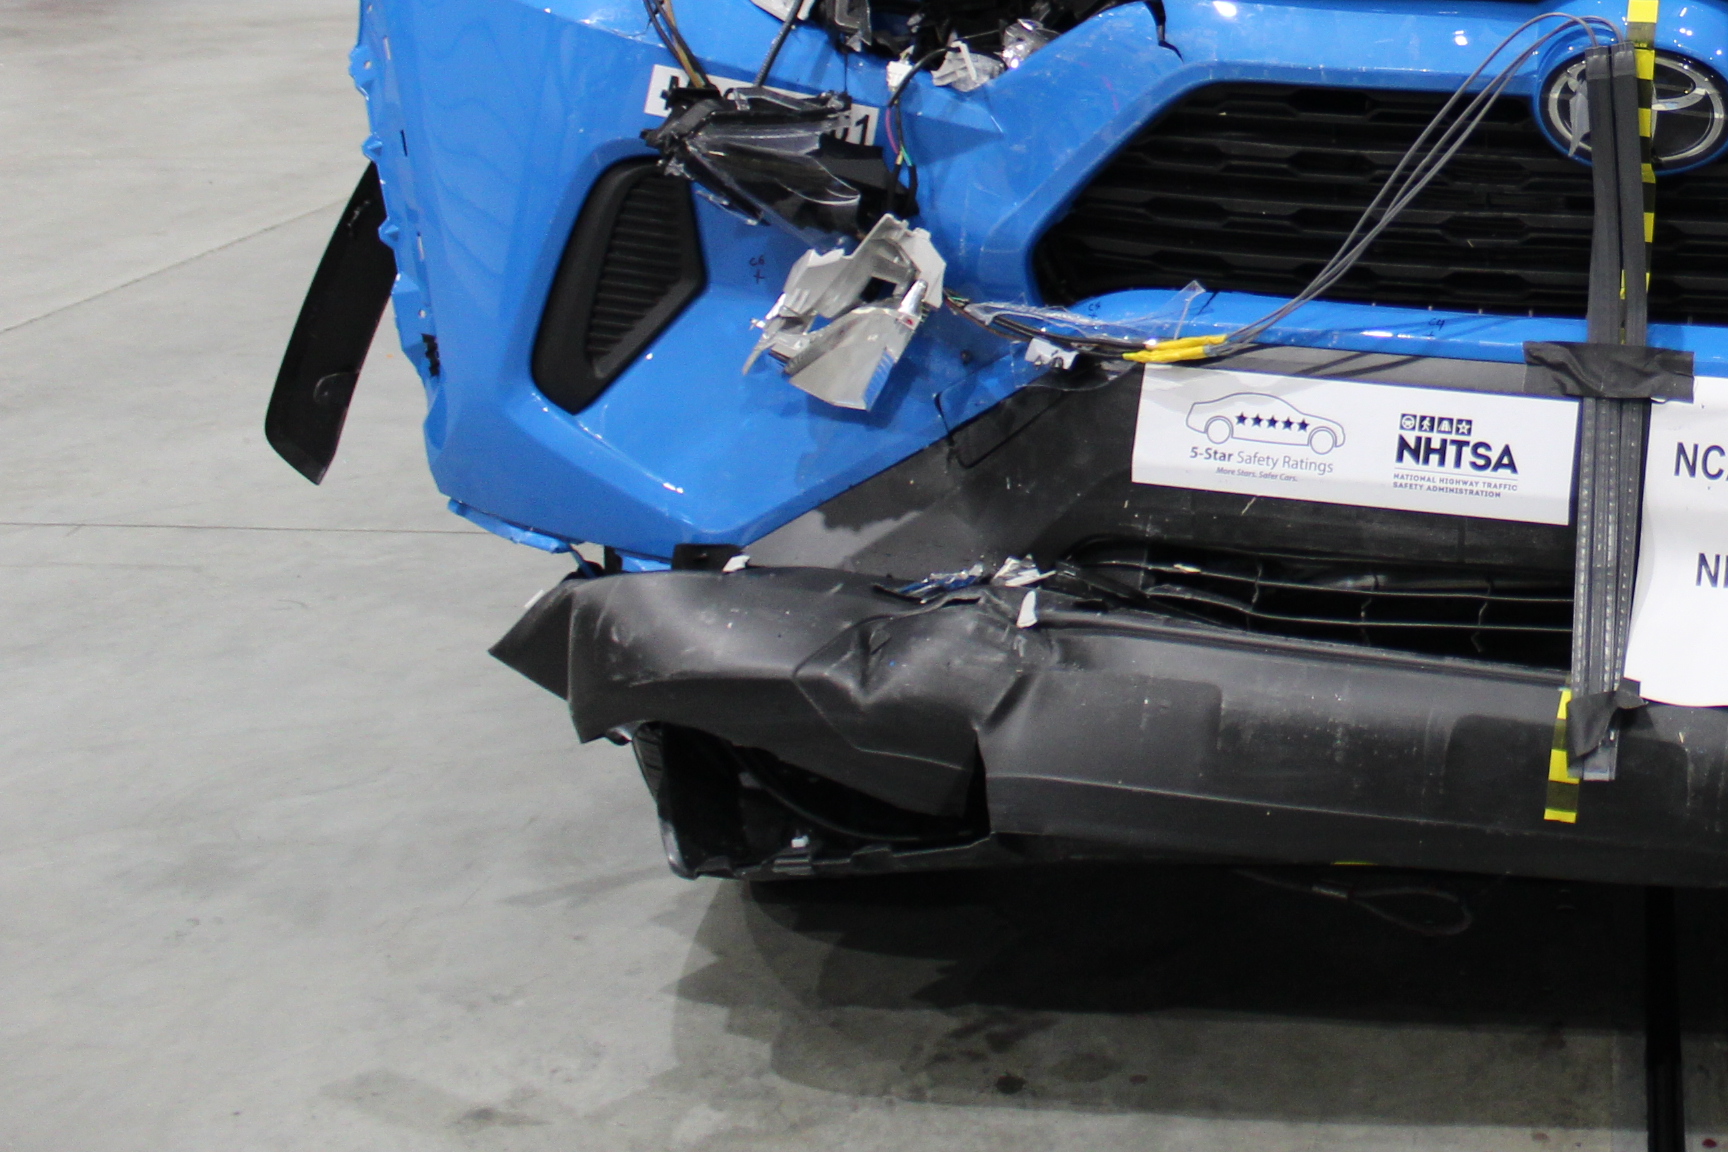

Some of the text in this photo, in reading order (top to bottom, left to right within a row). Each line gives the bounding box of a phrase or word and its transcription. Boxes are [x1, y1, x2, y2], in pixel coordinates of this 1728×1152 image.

[1191, 447, 1333, 475] 5-Star Safety Ratings
[1396, 434, 1518, 474] NHTSA
[1216, 467, 1298, 482] More Stars. Safer Cars.
[1394, 474, 1517, 491] NATIONAL HIGHWAY TRAFFIC
[1393, 482, 1500, 497] SAFETY ADMINISTRATION
